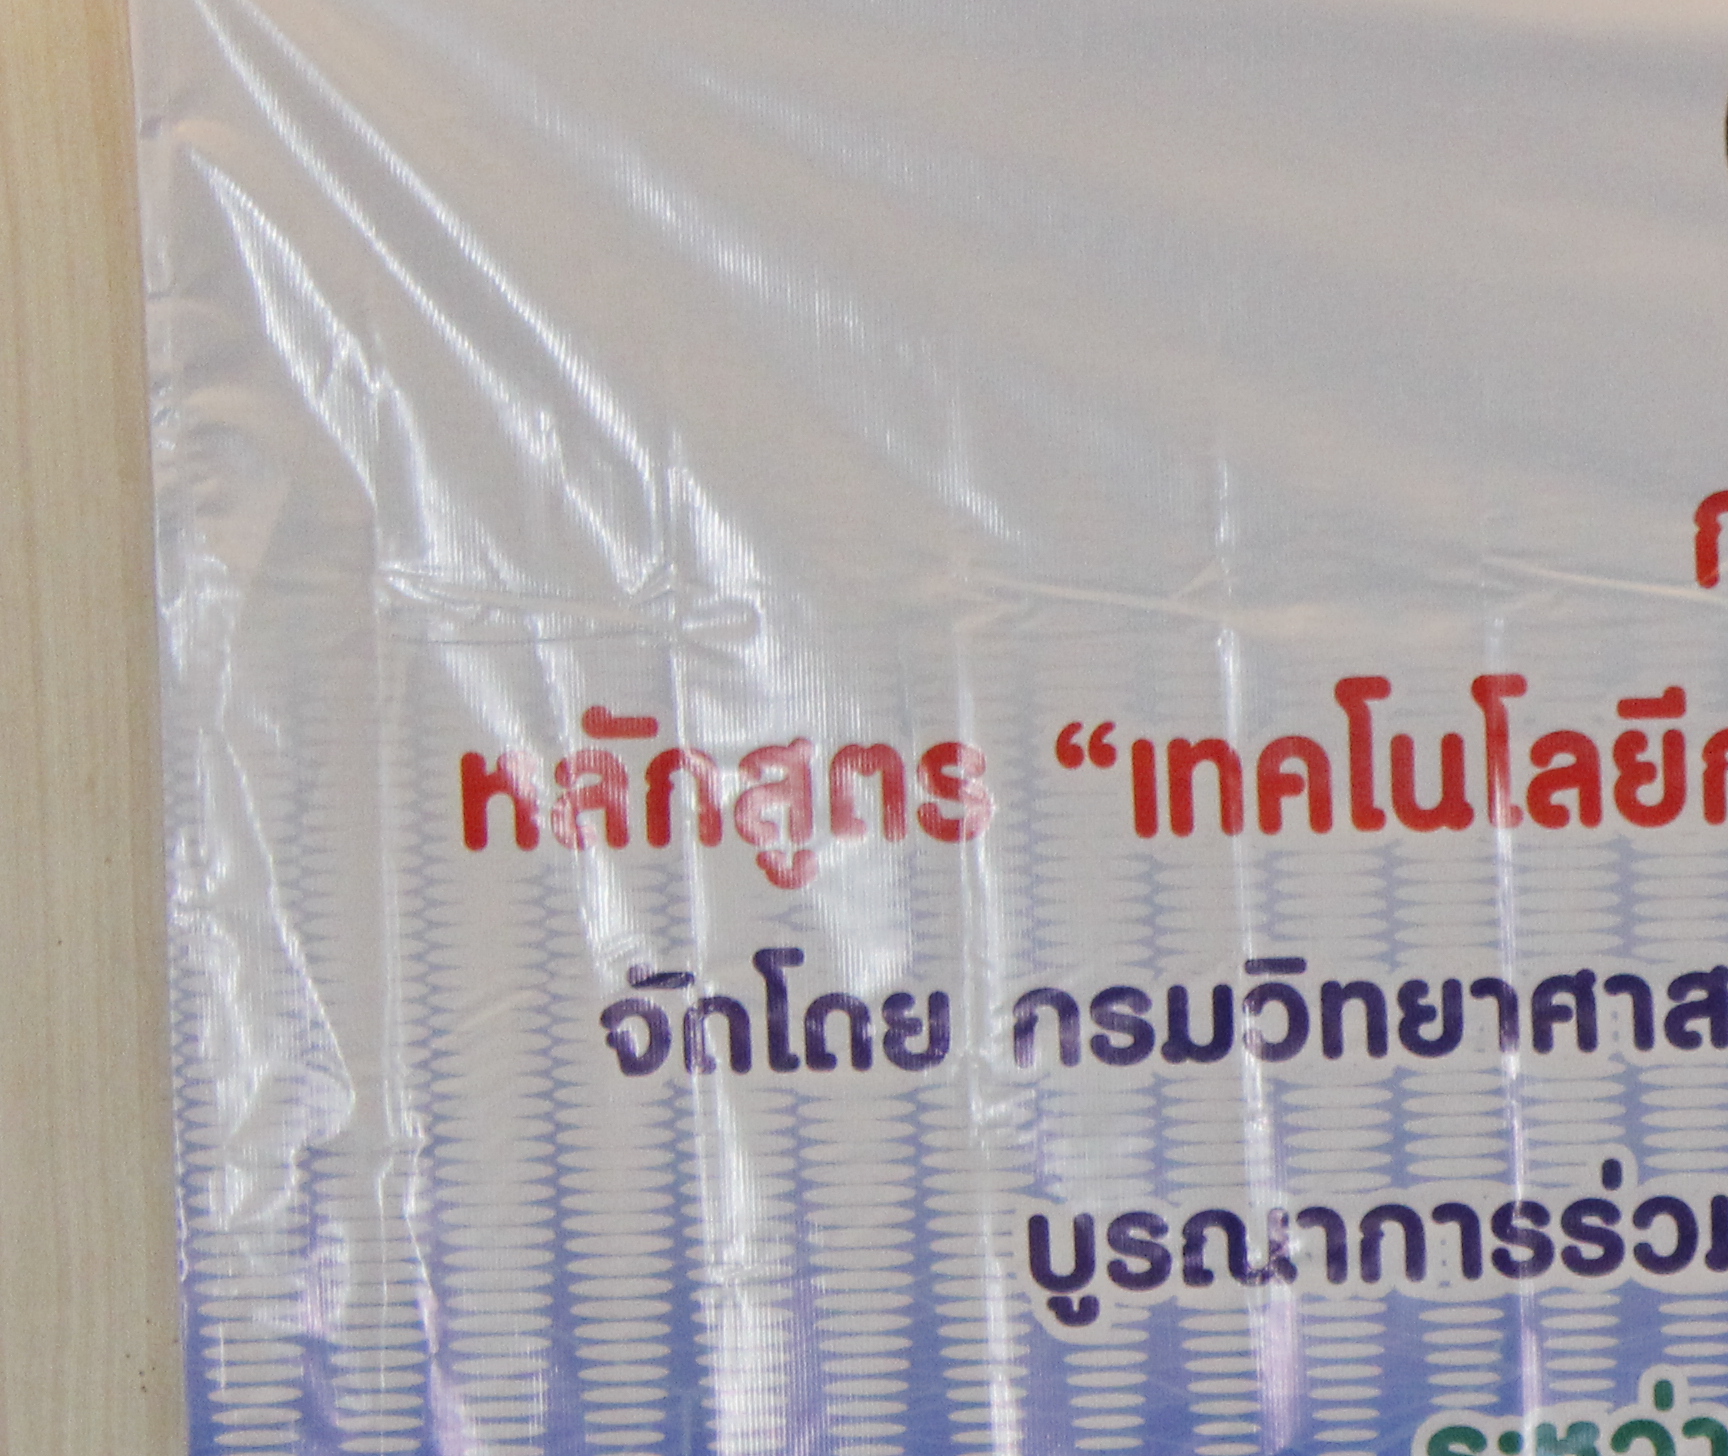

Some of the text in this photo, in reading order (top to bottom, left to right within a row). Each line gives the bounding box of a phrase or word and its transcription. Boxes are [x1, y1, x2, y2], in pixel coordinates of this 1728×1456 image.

[458, 705, 994, 890] หลักสูตร
[600, 946, 951, 1077] จัดโดย
